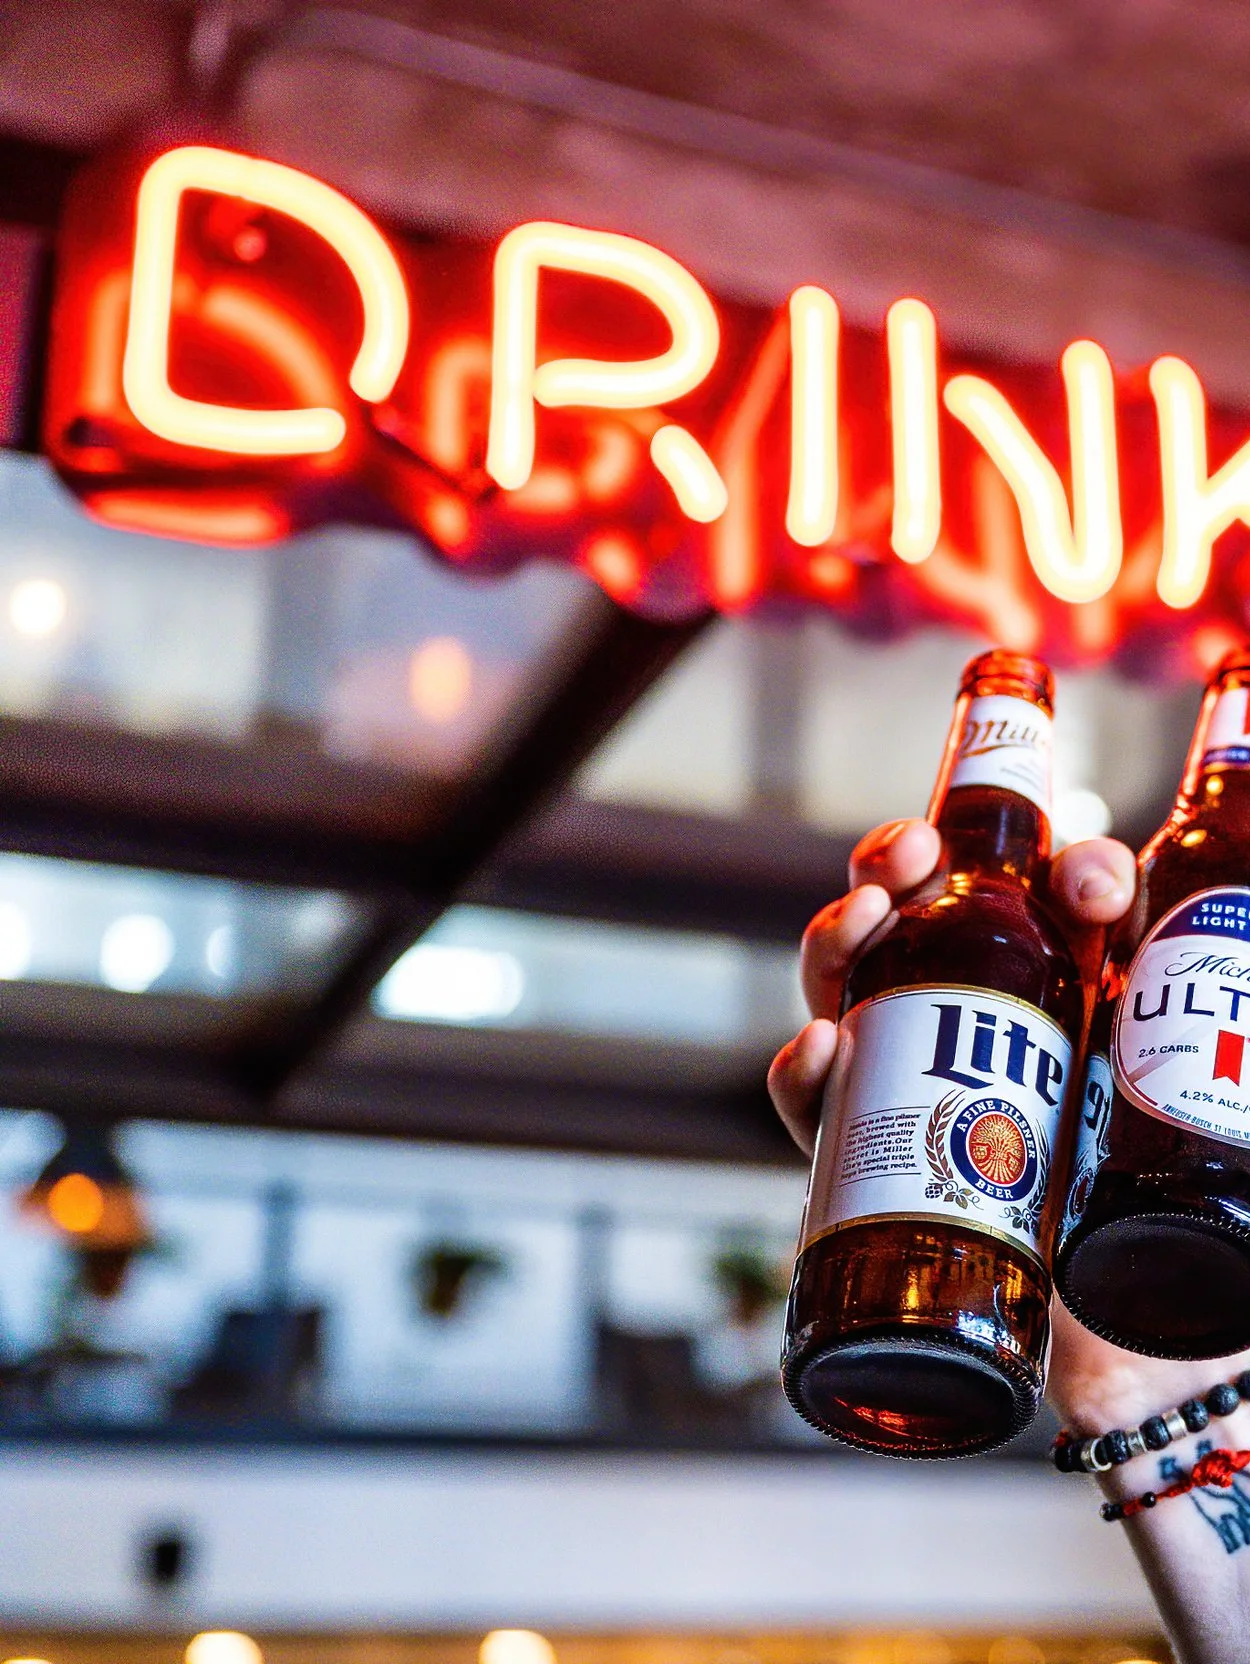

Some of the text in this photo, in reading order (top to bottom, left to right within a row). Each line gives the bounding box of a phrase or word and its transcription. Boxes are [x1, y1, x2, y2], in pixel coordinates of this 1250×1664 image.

[1192, 916, 1246, 931] LIGHT
[921, 1004, 1063, 1106] Lite
[1138, 1044, 1200, 1058] 2.6 CARBS
[1180, 1090, 1214, 1103] 4.2%
[895, 1113, 921, 1121] pilsner
[866, 1122, 895, 1133] brewed
[956, 1100, 1036, 1160] A FINE PILSNER
[858, 1132, 884, 1144] highest
[886, 1130, 914, 1138] quality
[863, 1154, 890, 1166] special
[891, 1154, 915, 1162] triple
[858, 1162, 889, 1174] brewing
[974, 1178, 1014, 1200] BEER
